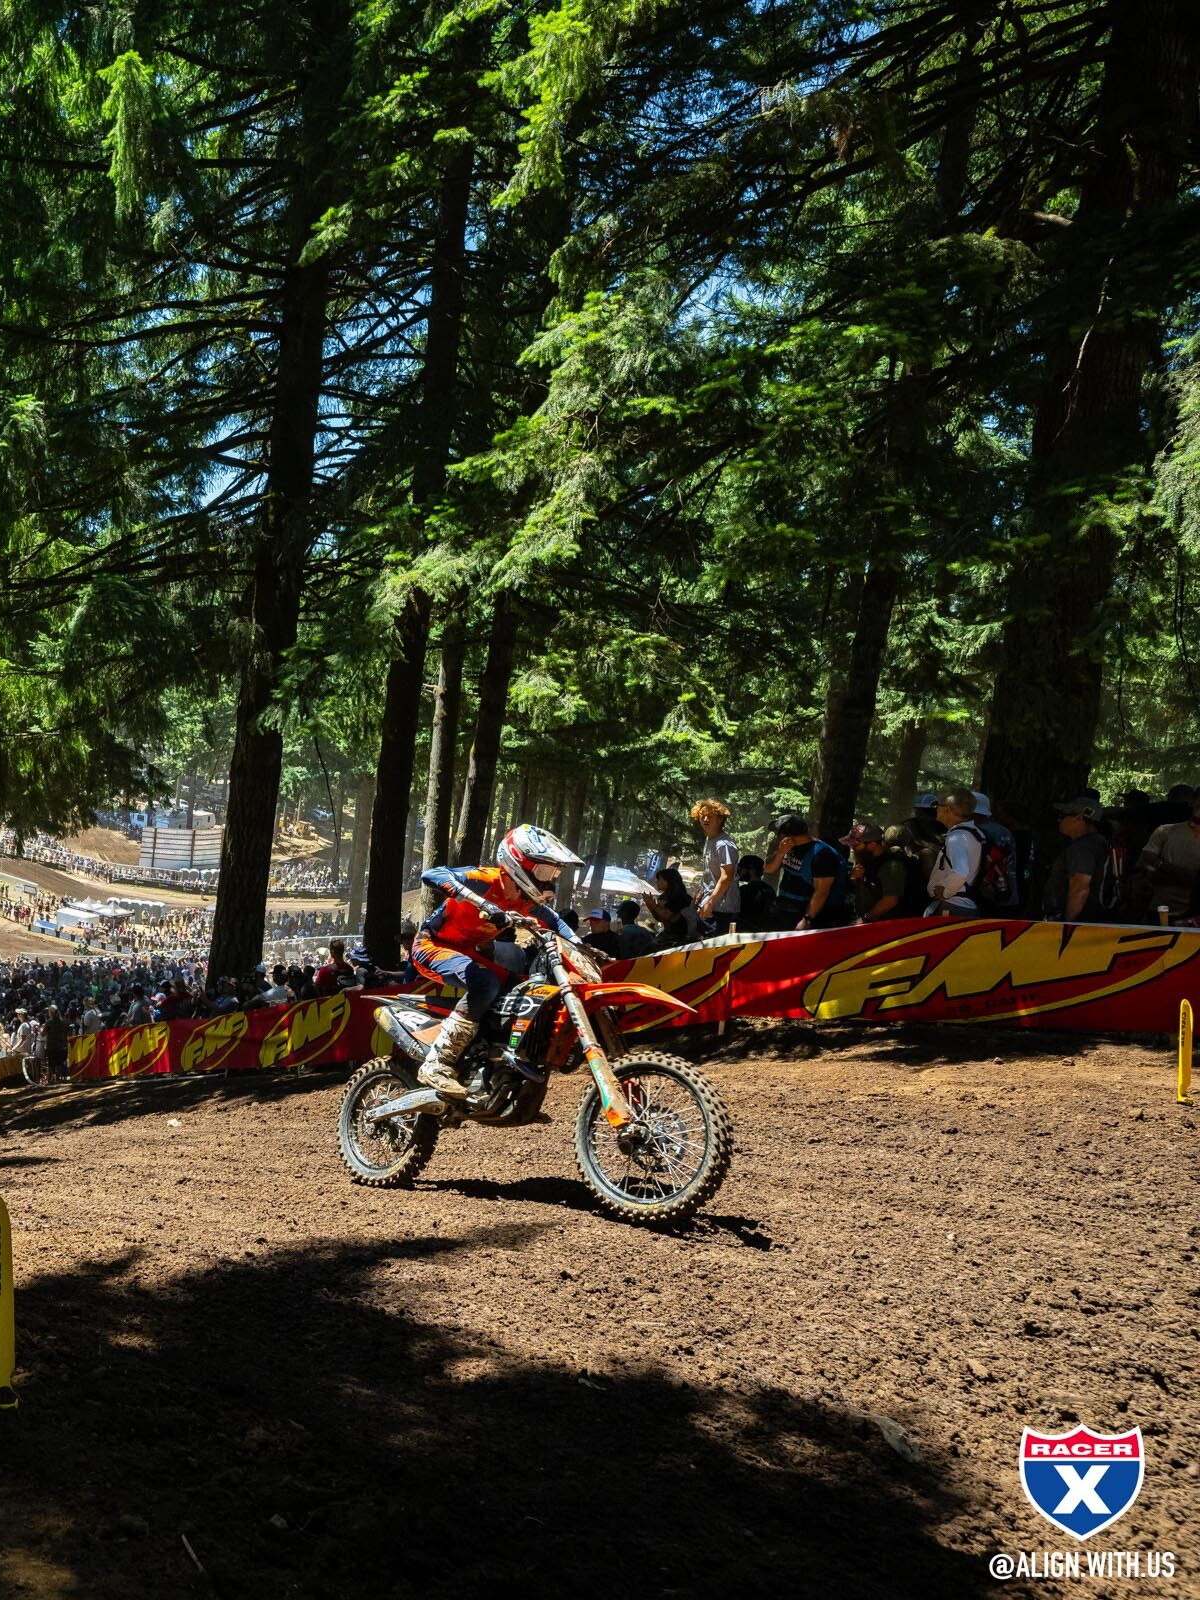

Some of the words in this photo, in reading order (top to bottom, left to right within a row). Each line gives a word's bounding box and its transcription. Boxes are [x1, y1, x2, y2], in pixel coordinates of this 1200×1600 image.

[815, 922, 1177, 1020] FMF
[67, 1033, 96, 1069] MF
[110, 1021, 168, 1076] FMF
[183, 1011, 245, 1071] FMF
[261, 992, 346, 1068] FMF
